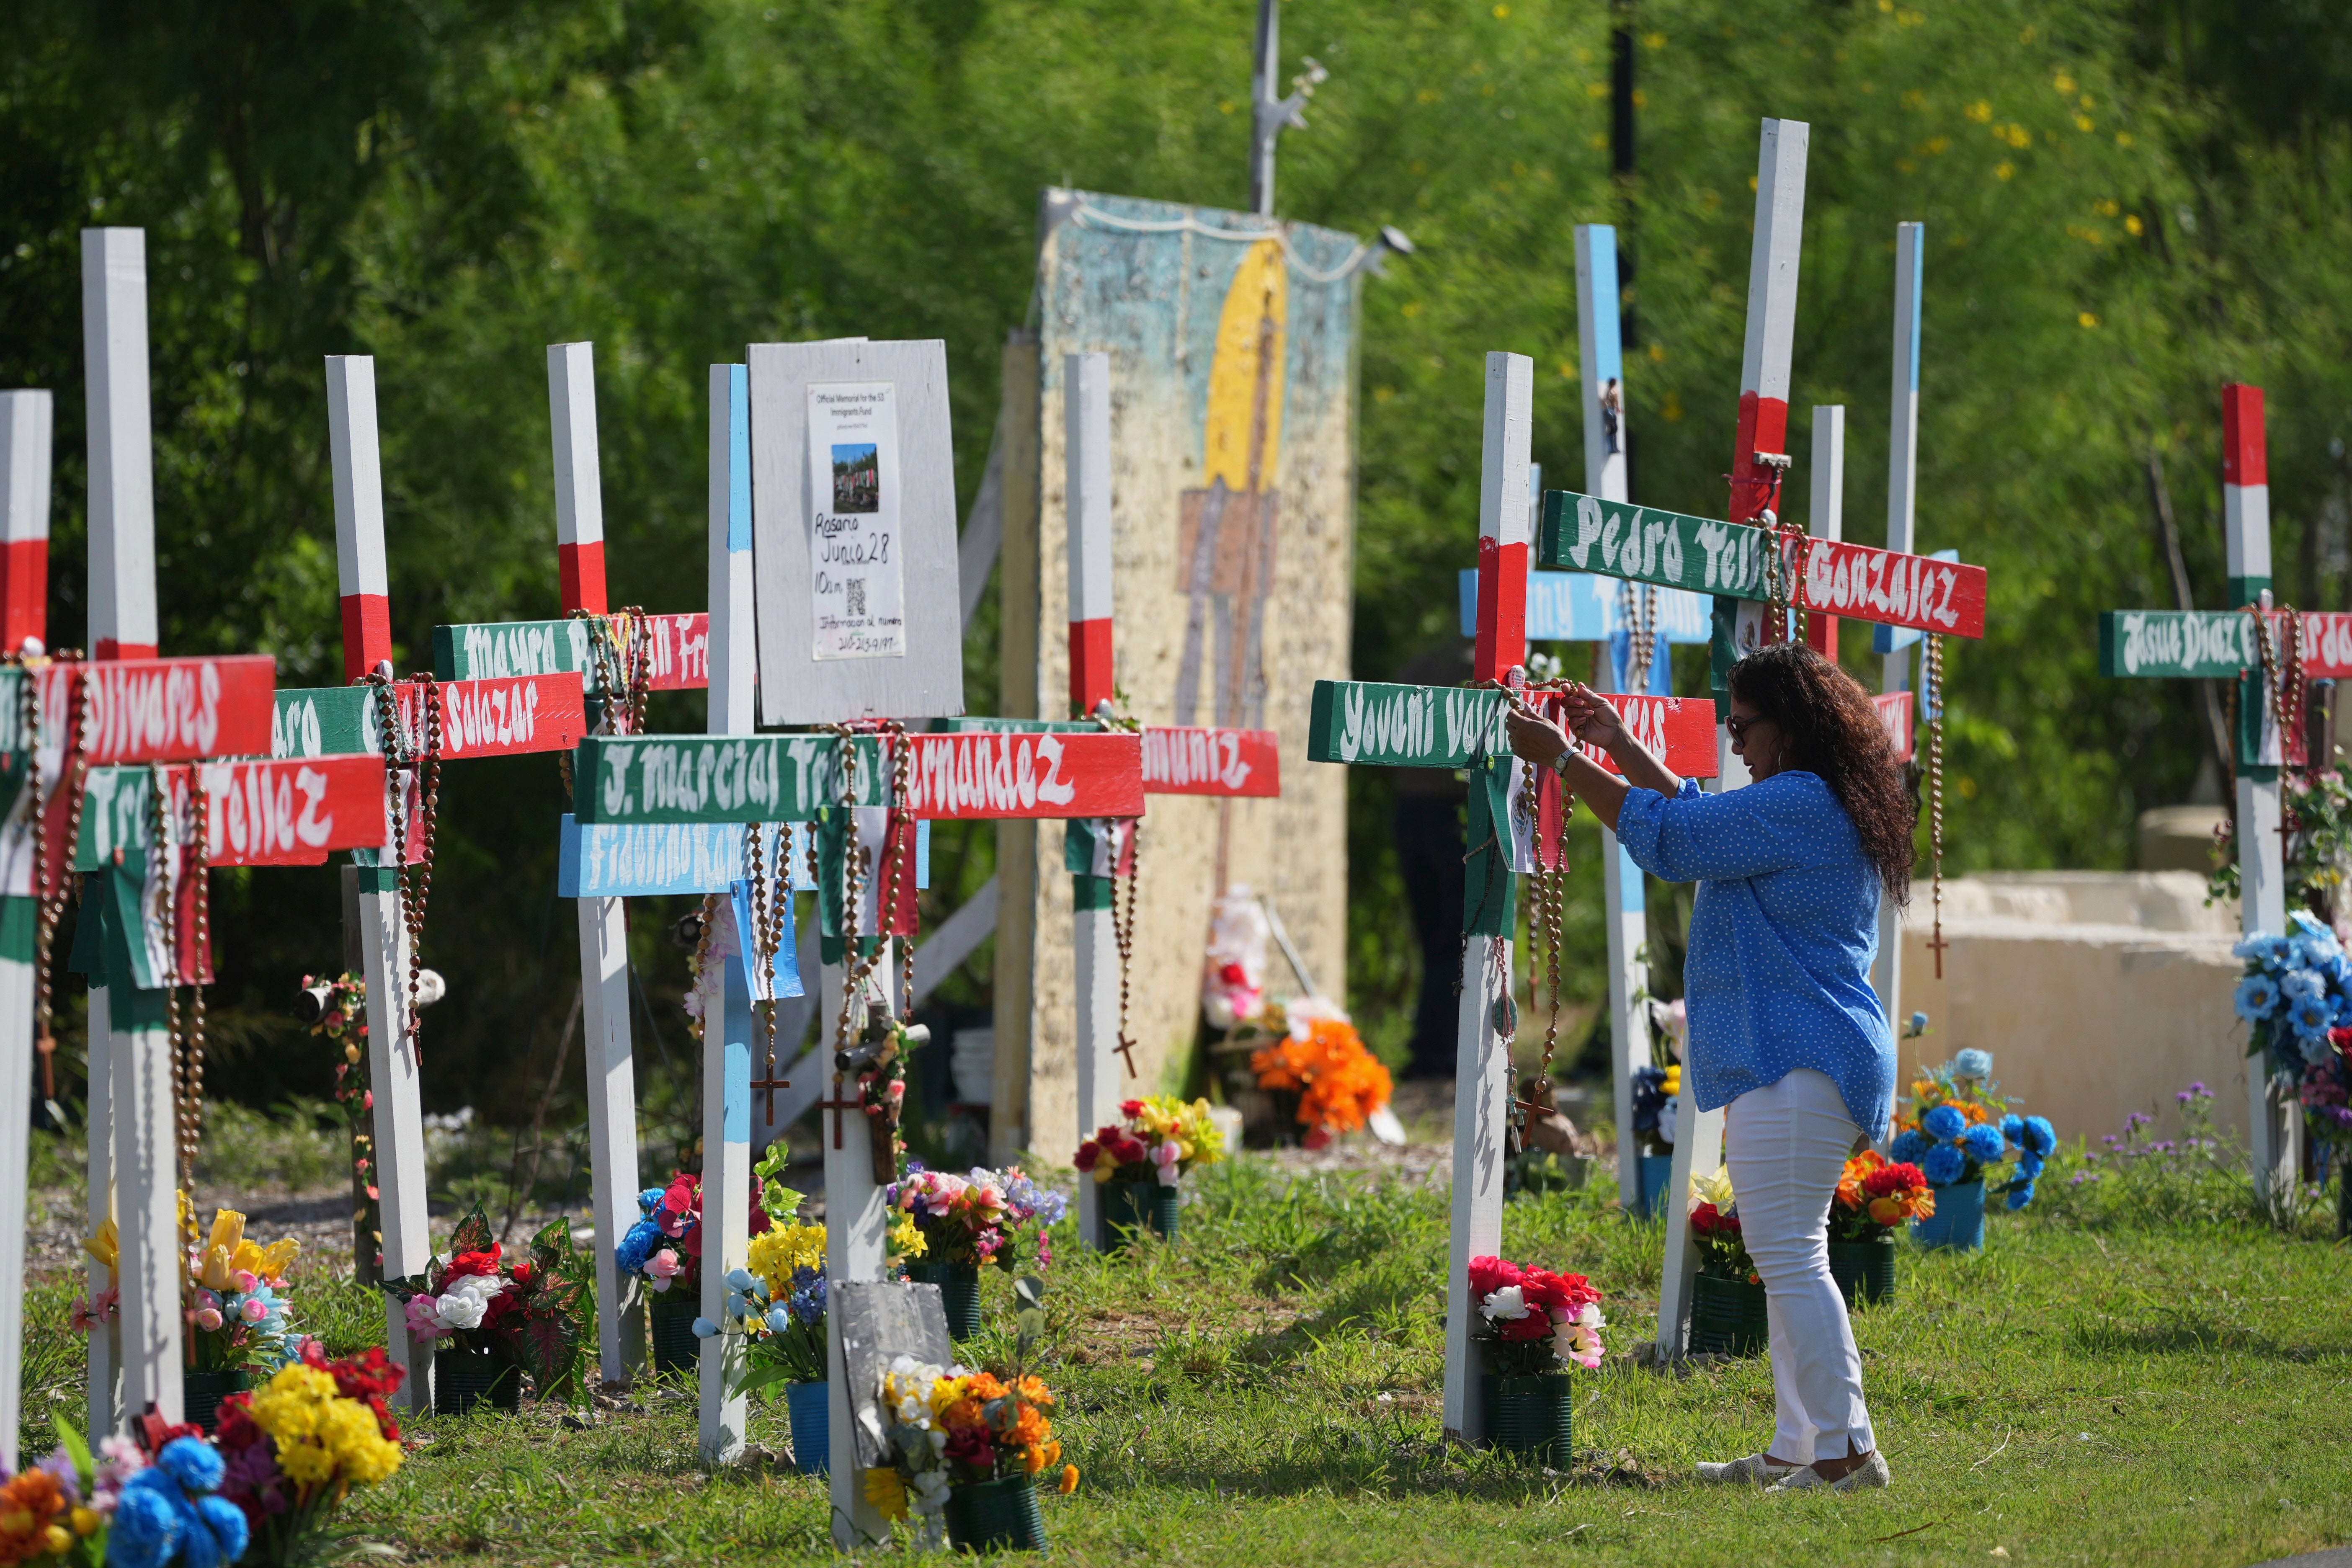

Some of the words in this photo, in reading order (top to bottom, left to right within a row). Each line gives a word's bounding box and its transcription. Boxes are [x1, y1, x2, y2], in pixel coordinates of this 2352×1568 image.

[817, 394, 834, 403] Official
[836, 394, 859, 402] Memorial
[868, 392, 876, 402] the
[830, 407, 858, 418] Immigrants
[859, 406, 872, 415] Fund
[815, 513, 858, 538] Rosario
[821, 535, 863, 562] Junio
[869, 532, 889, 564] 28
[1568, 496, 1684, 583] Pedro
[1806, 539, 1960, 629] Gonzalez
[867, 615, 875, 627] al
[878, 617, 902, 626] numero
[2122, 613, 2181, 675] Josue
[2180, 612, 2240, 671] Diaz
[447, 680, 538, 753] Salazar
[1339, 682, 1434, 763] Yovani
[1446, 688, 1549, 759] Valen
[603, 743, 635, 816] J.
[639, 738, 779, 815] Marcial
[201, 762, 333, 859] Tellez
